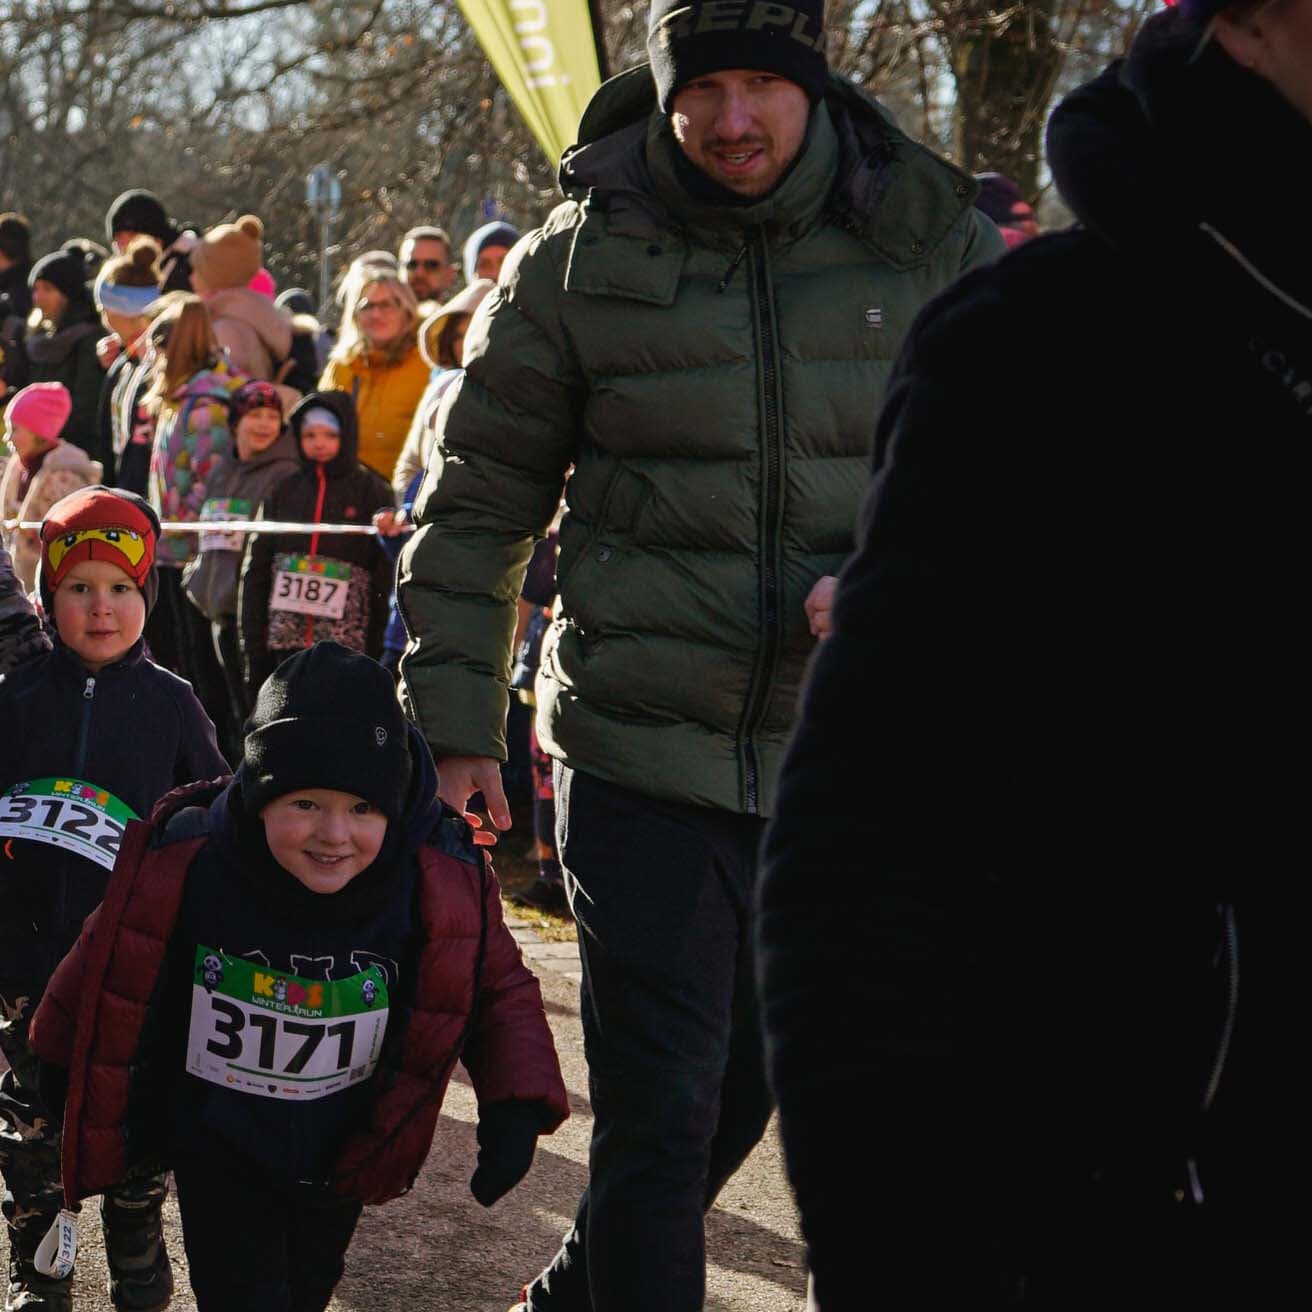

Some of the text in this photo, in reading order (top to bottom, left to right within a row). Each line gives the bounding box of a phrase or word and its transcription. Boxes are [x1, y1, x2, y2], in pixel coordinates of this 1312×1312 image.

[279, 576, 338, 602] 3187
[0, 797, 125, 856] 3122
[206, 996, 356, 1075] 3171
[62, 1225, 72, 1259] 3122
